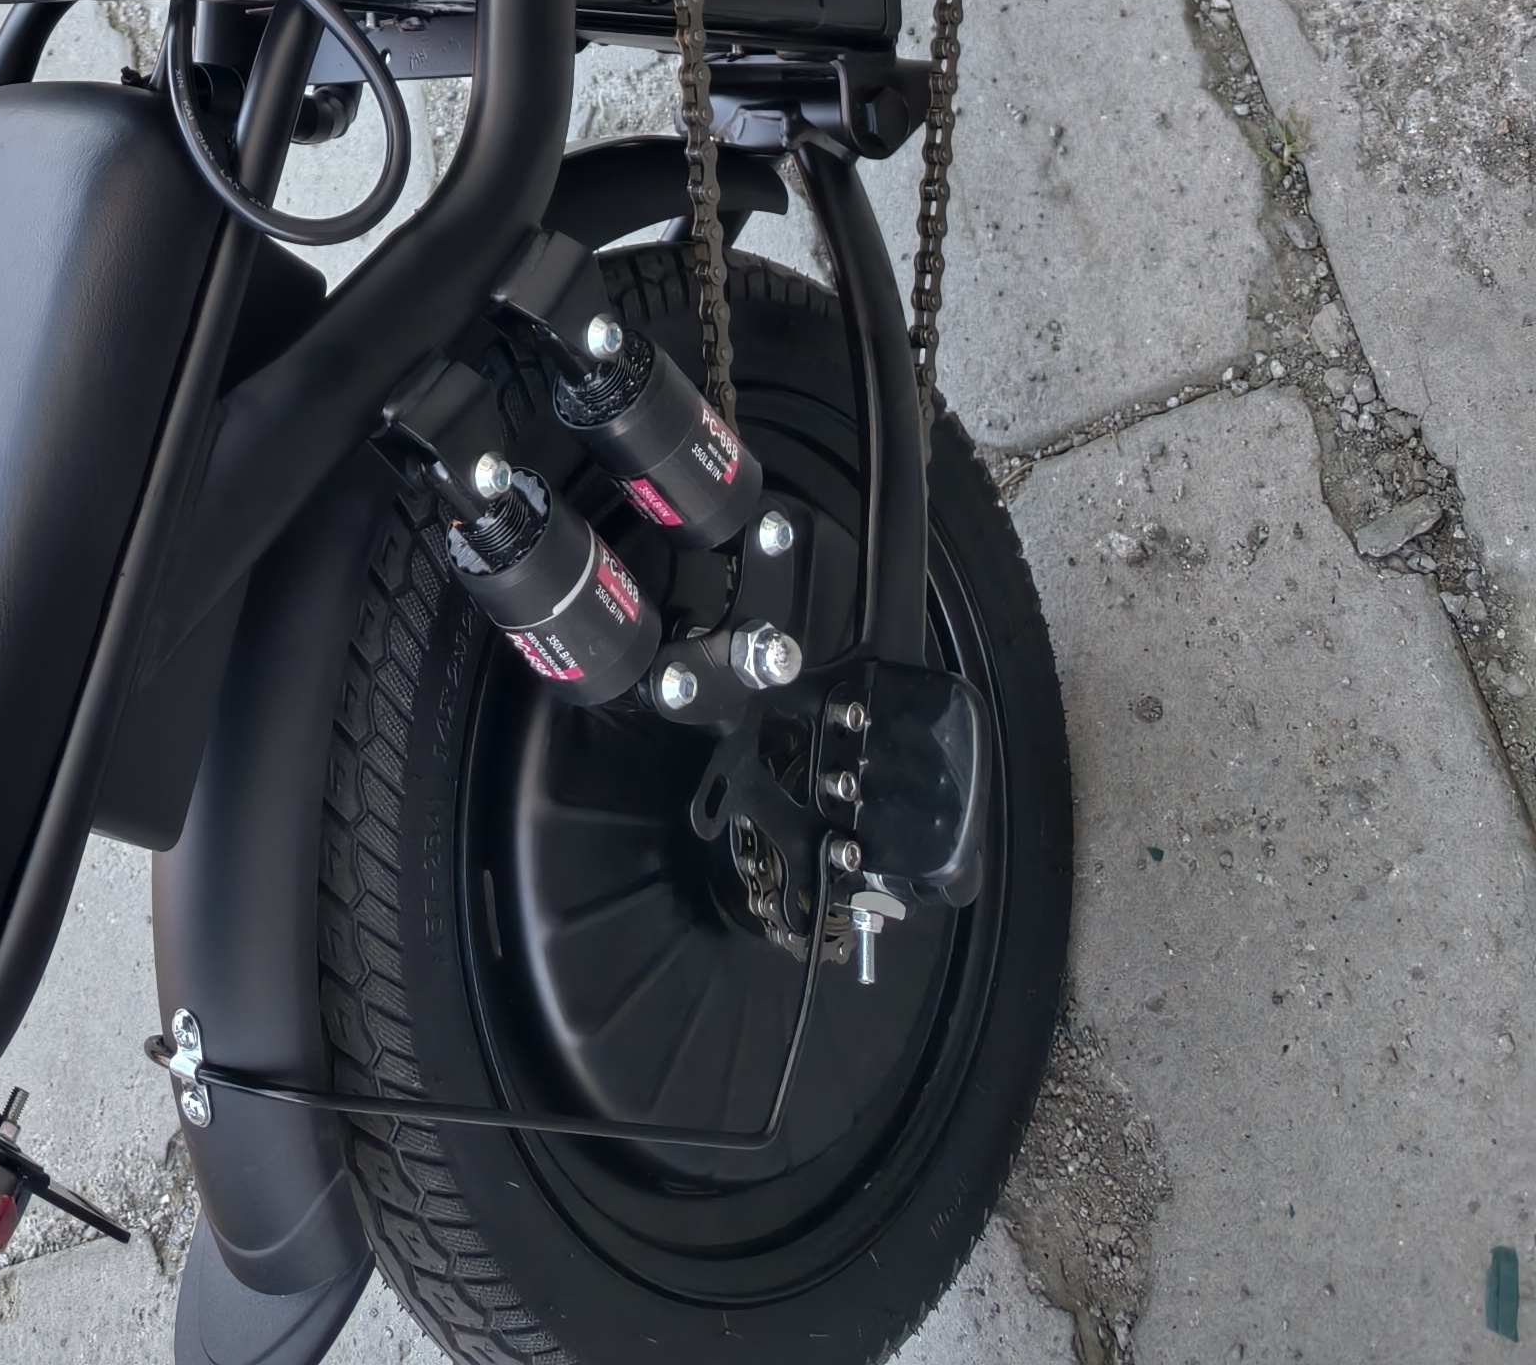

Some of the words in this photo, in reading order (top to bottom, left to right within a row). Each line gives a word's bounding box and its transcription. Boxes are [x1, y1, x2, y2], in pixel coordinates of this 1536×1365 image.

[174, 68, 185, 89] XIN
[219, 169, 241, 191] LAN
[701, 408, 739, 462] PC-688
[691, 443, 723, 482] 350LB/IN
[602, 548, 640, 604] PC-688
[595, 584, 626, 626] 350LB/IN
[545, 633, 578, 670] 350LB/IN
